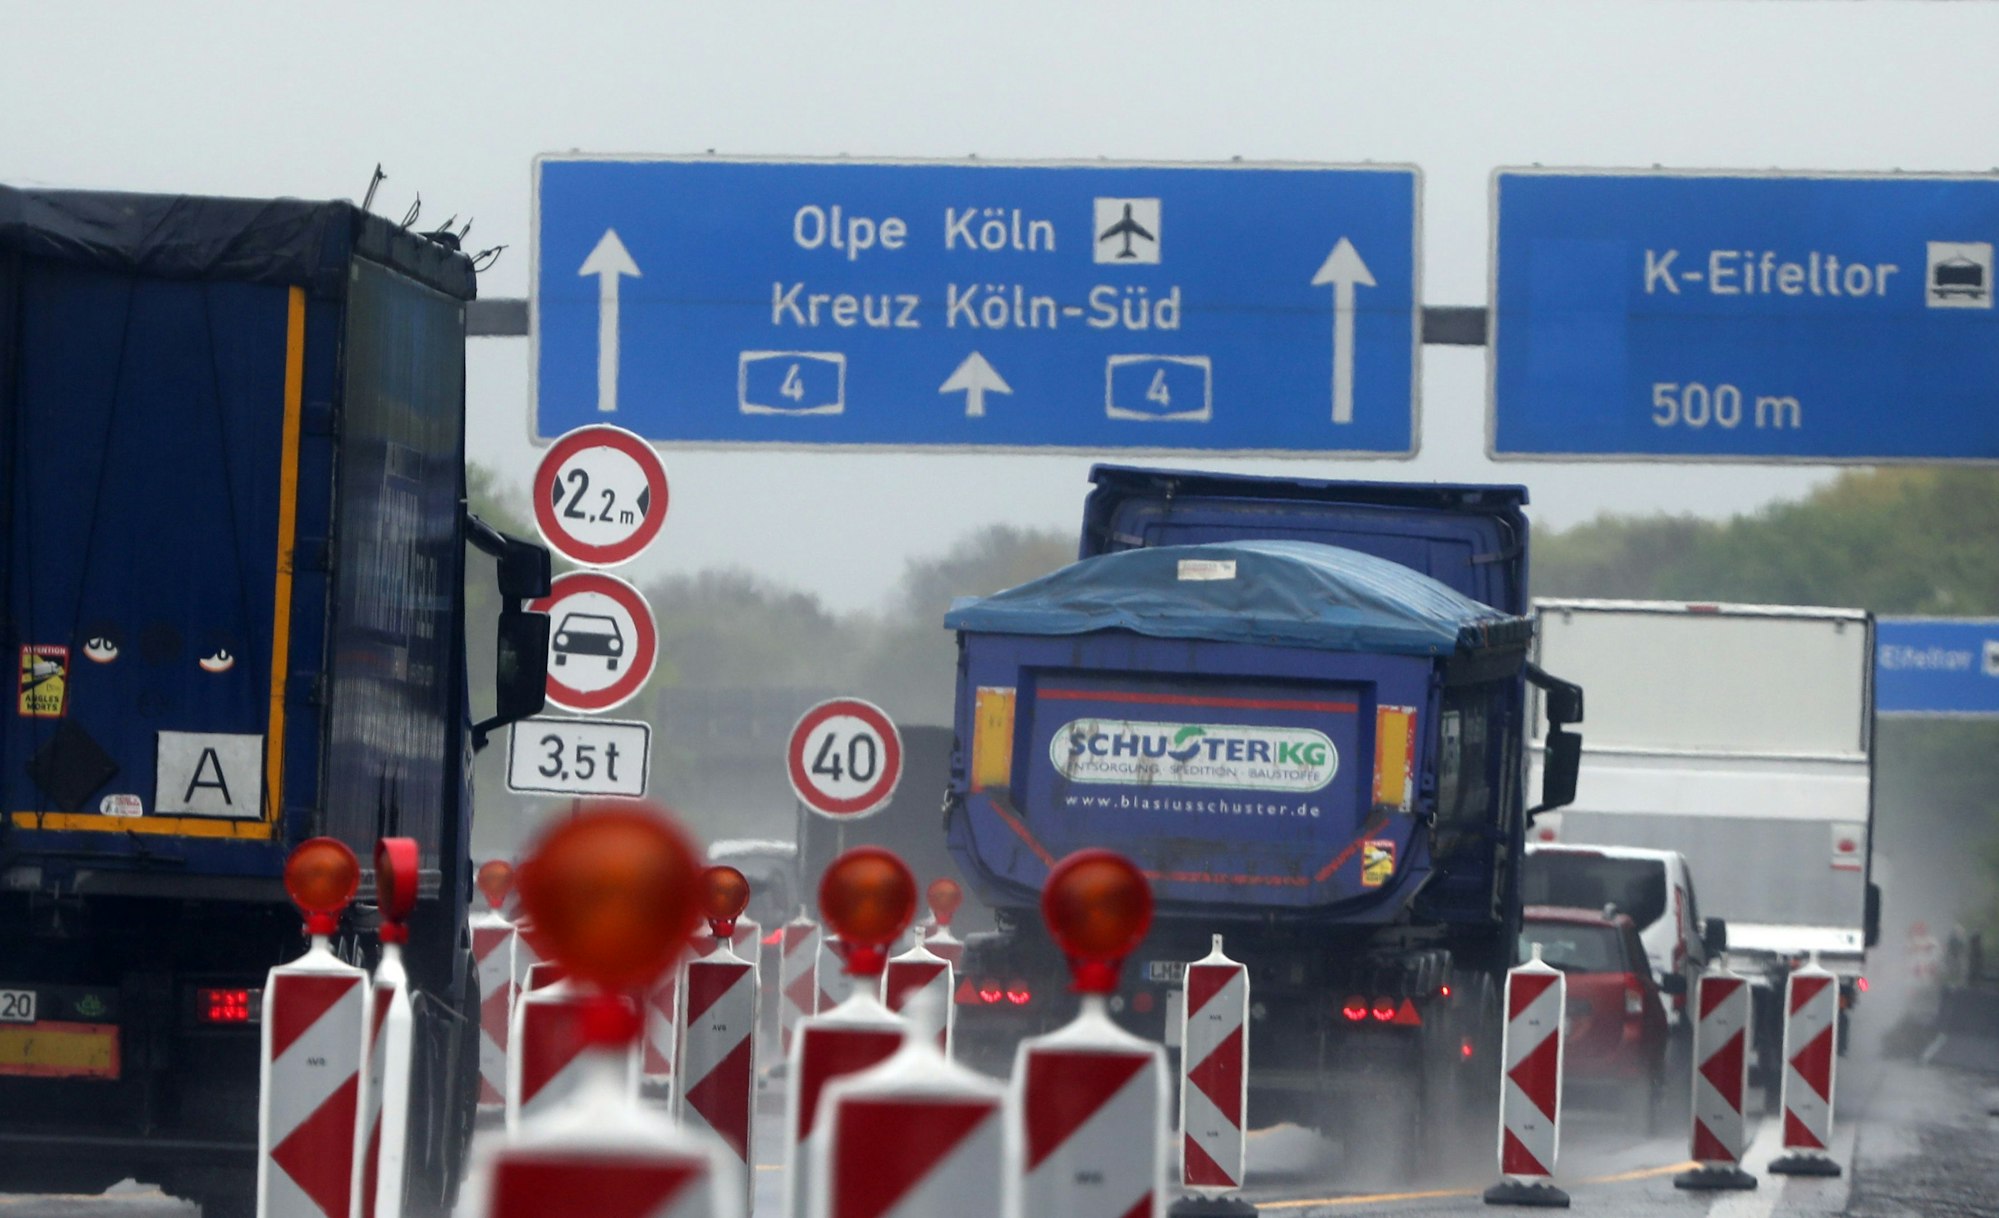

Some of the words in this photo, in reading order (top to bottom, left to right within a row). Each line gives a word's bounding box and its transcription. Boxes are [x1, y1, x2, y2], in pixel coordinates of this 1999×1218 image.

[794, 205, 907, 260] Olpe
[945, 203, 1055, 251] Köln
[1645, 249, 1898, 296] K-Eifeltor
[772, 282, 920, 328] Kreuz
[946, 284, 1181, 330] Köln-Süd
[780, 363, 804, 402] 4
[1146, 368, 1170, 406] 4
[1652, 382, 1741, 428] 500
[1755, 395, 1801, 429] m
[538, 734, 596, 781] 3,5
[606, 742, 620, 782] t
[811, 732, 876, 782] 40
[1069, 726, 1271, 763] SCHUSTER
[1278, 741, 1326, 766] KG
[183, 747, 233, 805] A
[1169, 764, 1237, 777] SPEDITION
[1248, 768, 1319, 782] BAUSTOFFE
[1065, 794, 1321, 818] www.blasiusschuster.de
[2, 992, 31, 1018] 20
